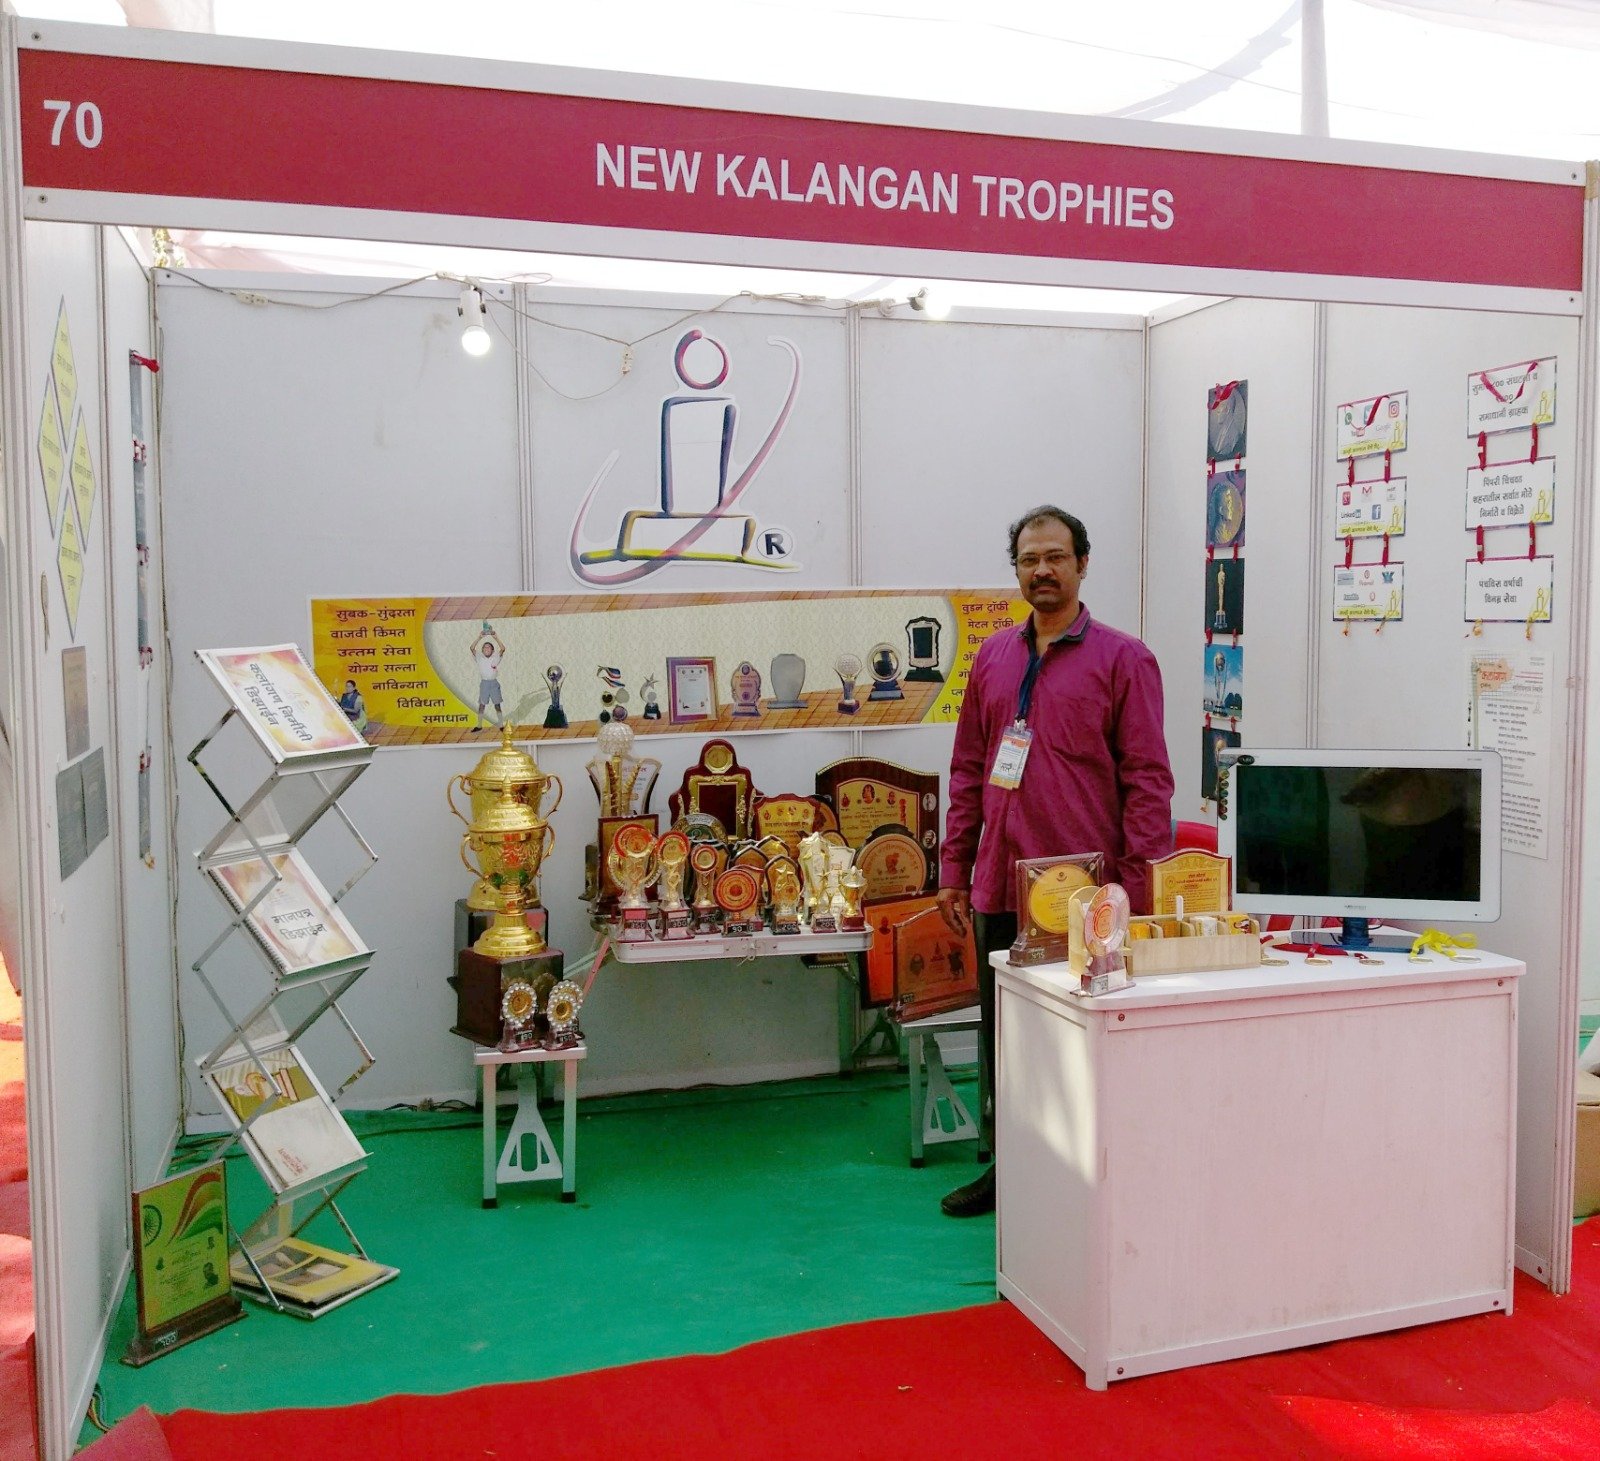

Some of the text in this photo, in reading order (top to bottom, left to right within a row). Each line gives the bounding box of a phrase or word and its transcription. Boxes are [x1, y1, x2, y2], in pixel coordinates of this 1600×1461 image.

[43, 99, 103, 149] 70
[596, 142, 1175, 231] NEW KALANGAN TROPHIES
[986, 601, 1009, 613] ट्रॉफी
[967, 617, 1014, 629] मेटल ट्रॉफी
[330, 626, 368, 639] वाजवी
[382, 644, 413, 656] सेवा
[348, 661, 417, 674] योग्य सल्ला
[372, 678, 429, 691] नाविन्यता
[396, 697, 446, 709] विविधता
[422, 714, 469, 724] समाधान
